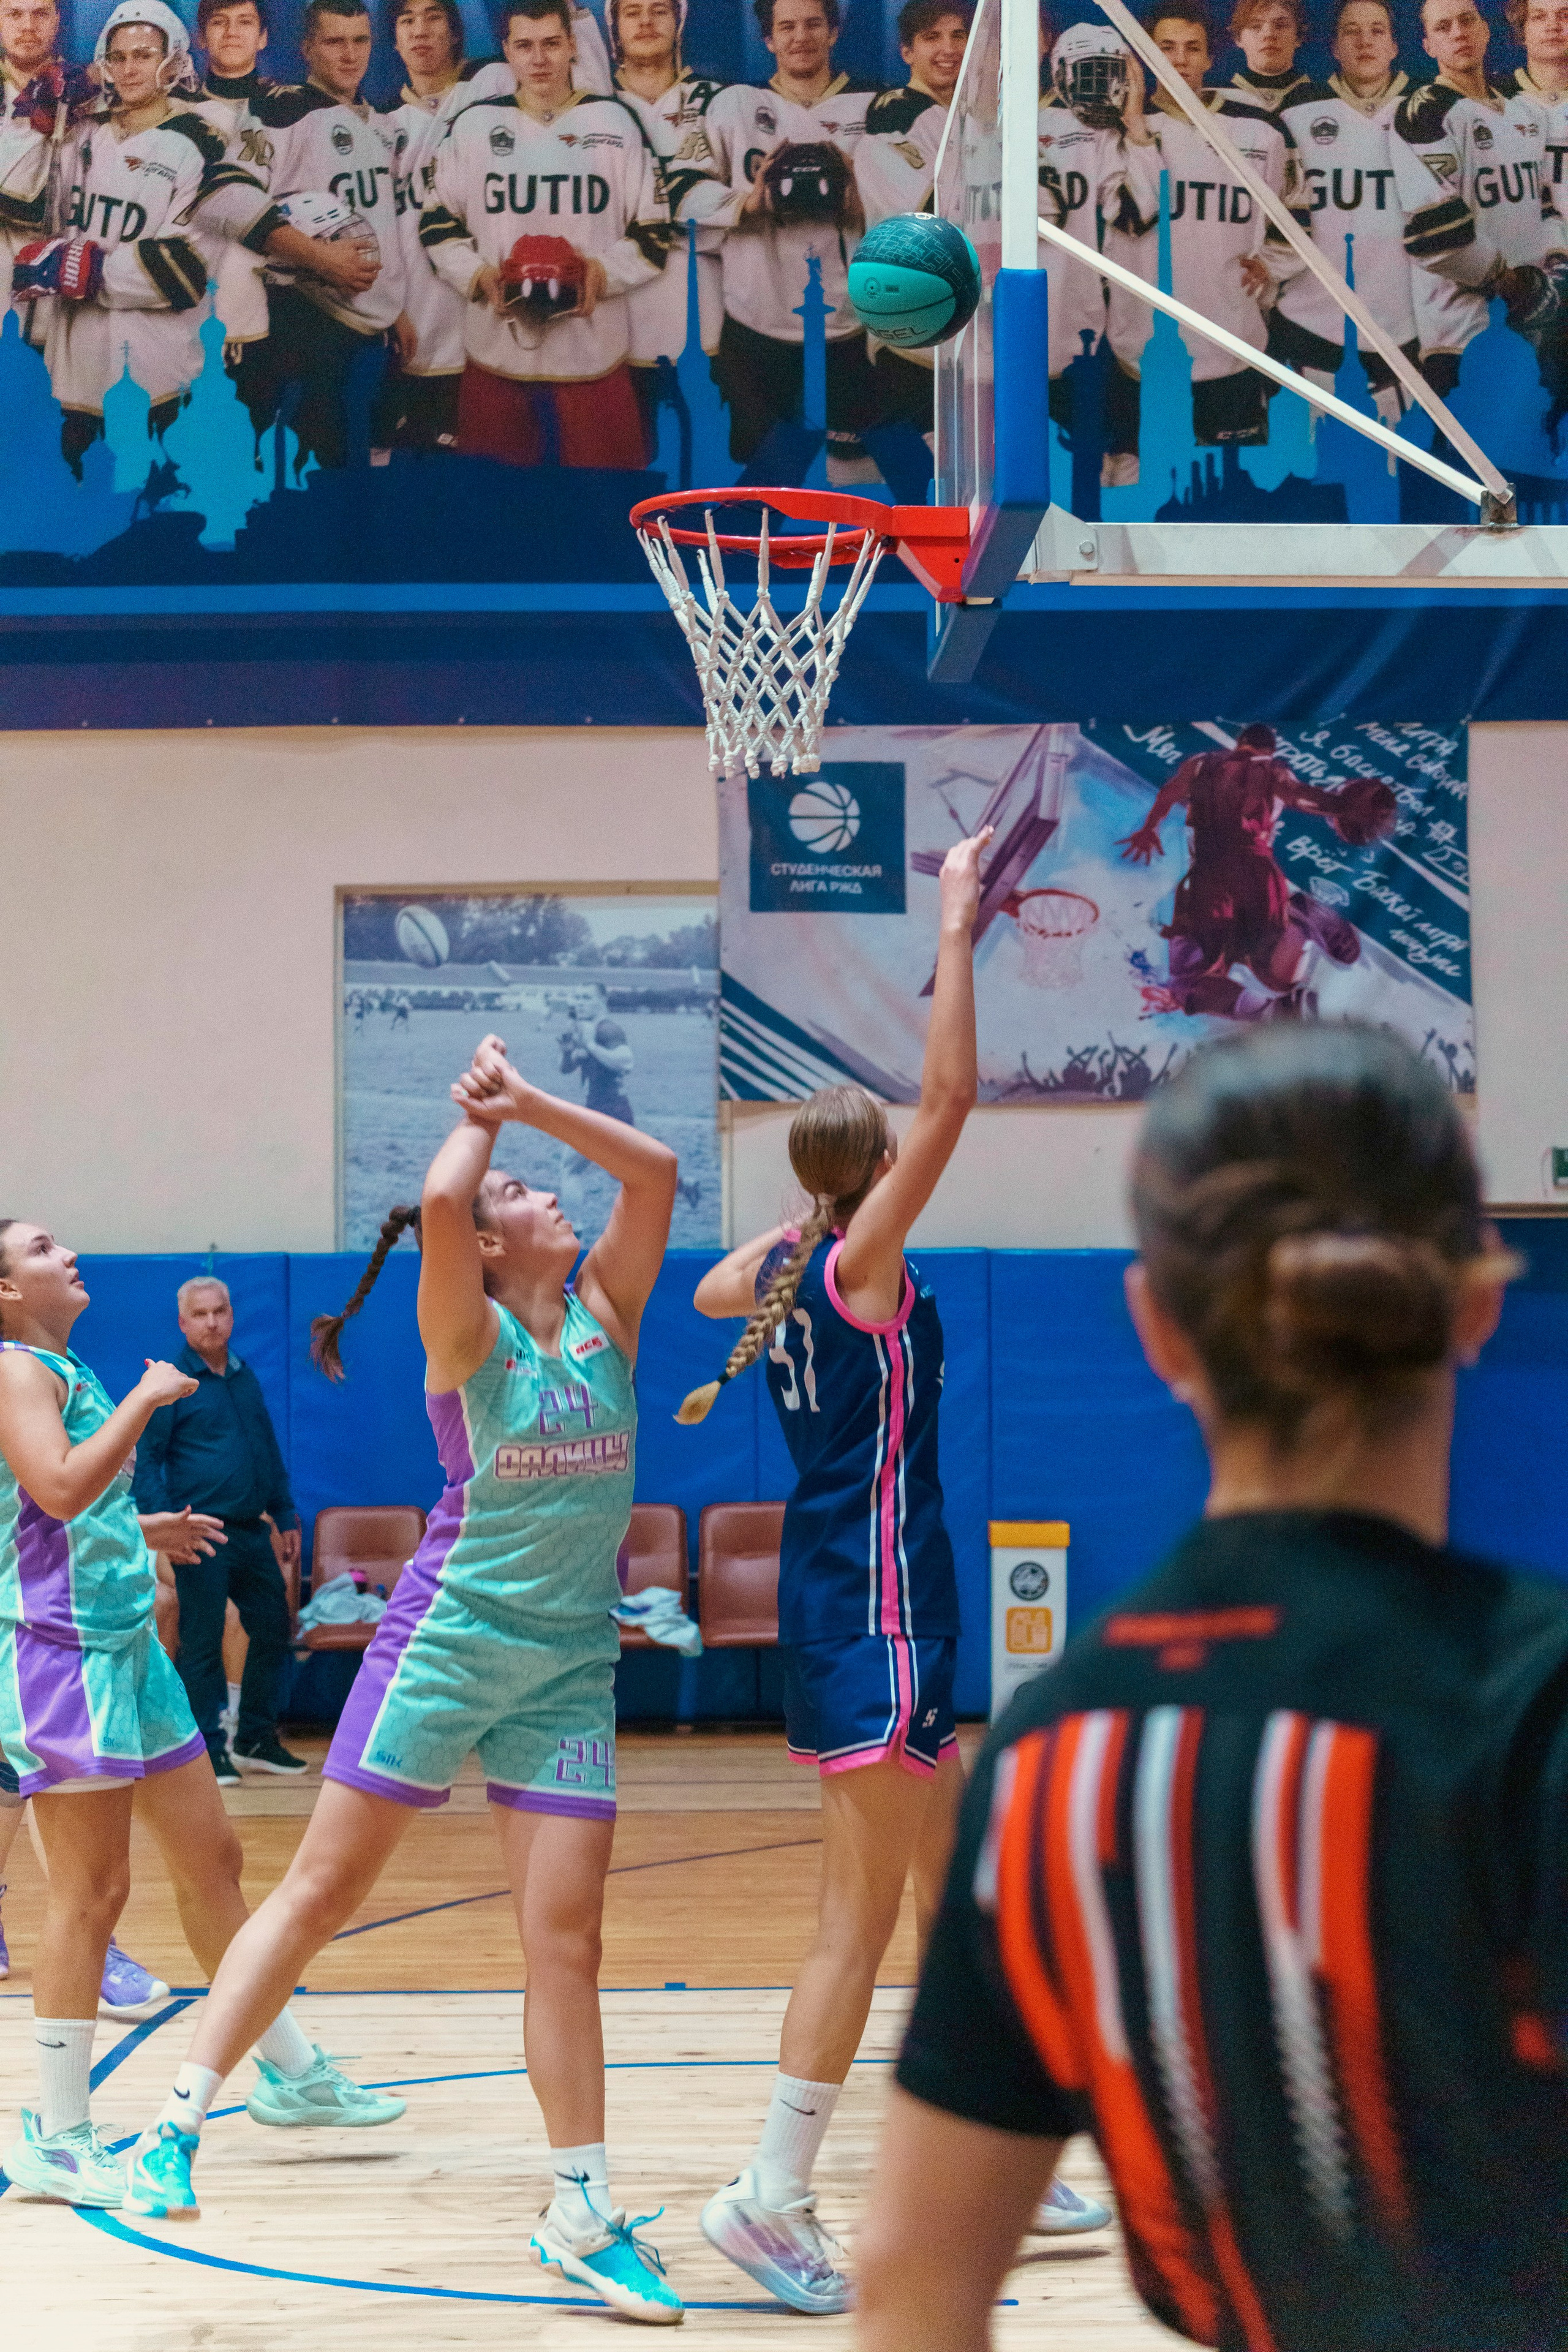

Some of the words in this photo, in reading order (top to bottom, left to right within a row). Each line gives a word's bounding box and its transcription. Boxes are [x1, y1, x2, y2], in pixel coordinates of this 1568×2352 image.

[485, 174, 610, 215] GUTID
[770, 862, 883, 878] СТУДЕНЧЕСКАЯ
[789, 879, 827, 894] ЛИГА
[829, 881, 864, 895] РЖД
[540, 1384, 599, 1435] 24
[556, 1738, 616, 1787] 24
